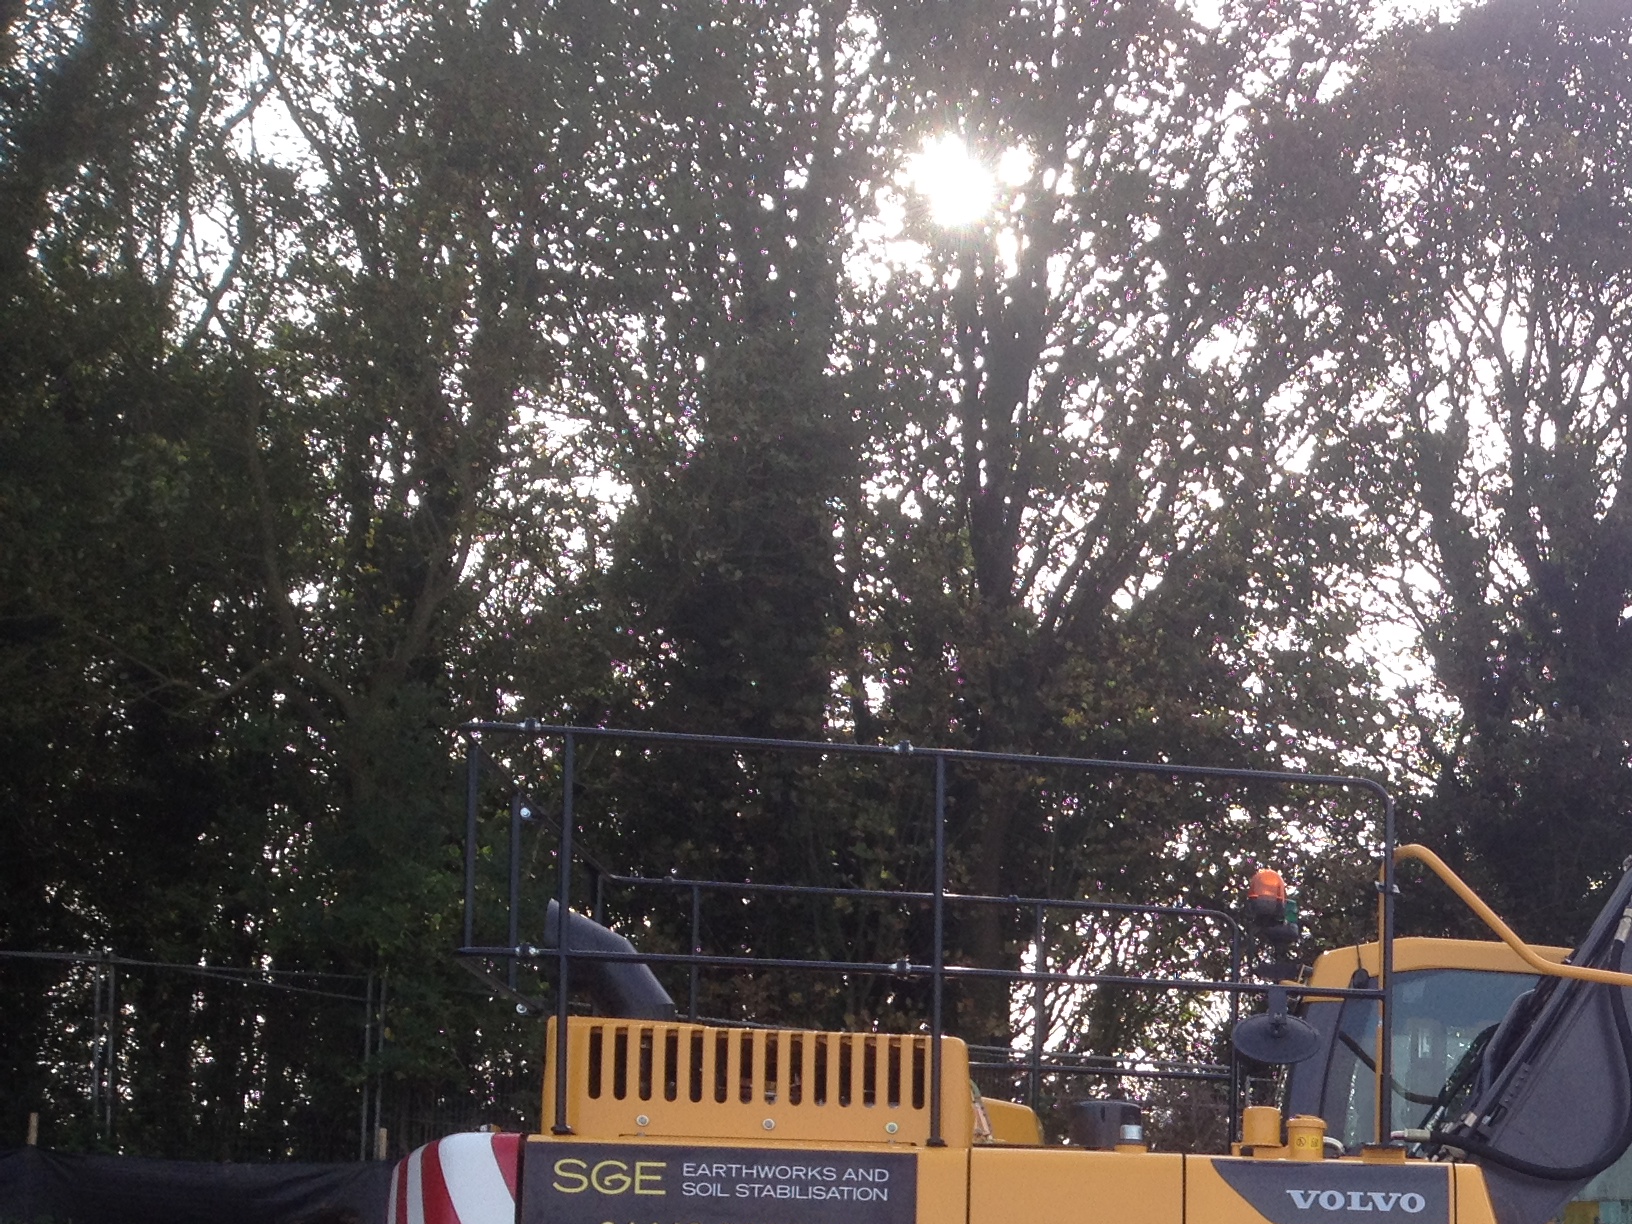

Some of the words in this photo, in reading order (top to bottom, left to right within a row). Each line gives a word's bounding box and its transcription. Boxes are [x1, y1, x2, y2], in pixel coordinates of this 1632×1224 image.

[552, 1158, 667, 1195] SGE
[682, 1163, 837, 1180] EARTHWORKS
[842, 1168, 889, 1182] AND
[682, 1182, 730, 1197] SOIL
[735, 1183, 888, 1201] STABILISATION
[1286, 1189, 1426, 1213] VOLVO
